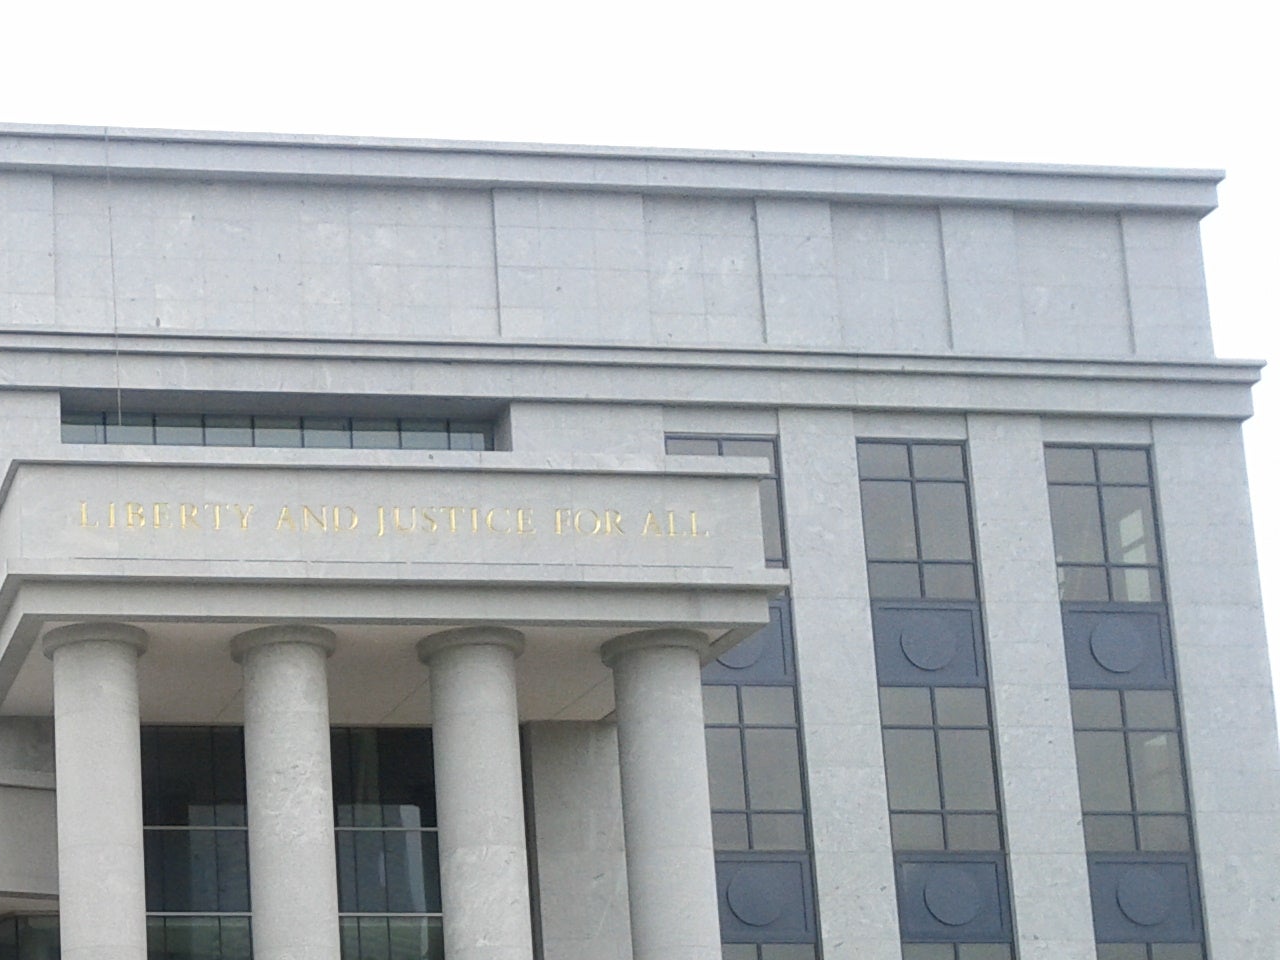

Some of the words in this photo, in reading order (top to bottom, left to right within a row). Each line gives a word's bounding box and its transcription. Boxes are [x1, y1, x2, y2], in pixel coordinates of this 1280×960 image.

[79, 501, 255, 530] LIBERTY
[275, 504, 360, 532] AND
[375, 505, 538, 537] JUSTICE
[554, 508, 625, 536] FOR
[640, 510, 711, 538] ALL
